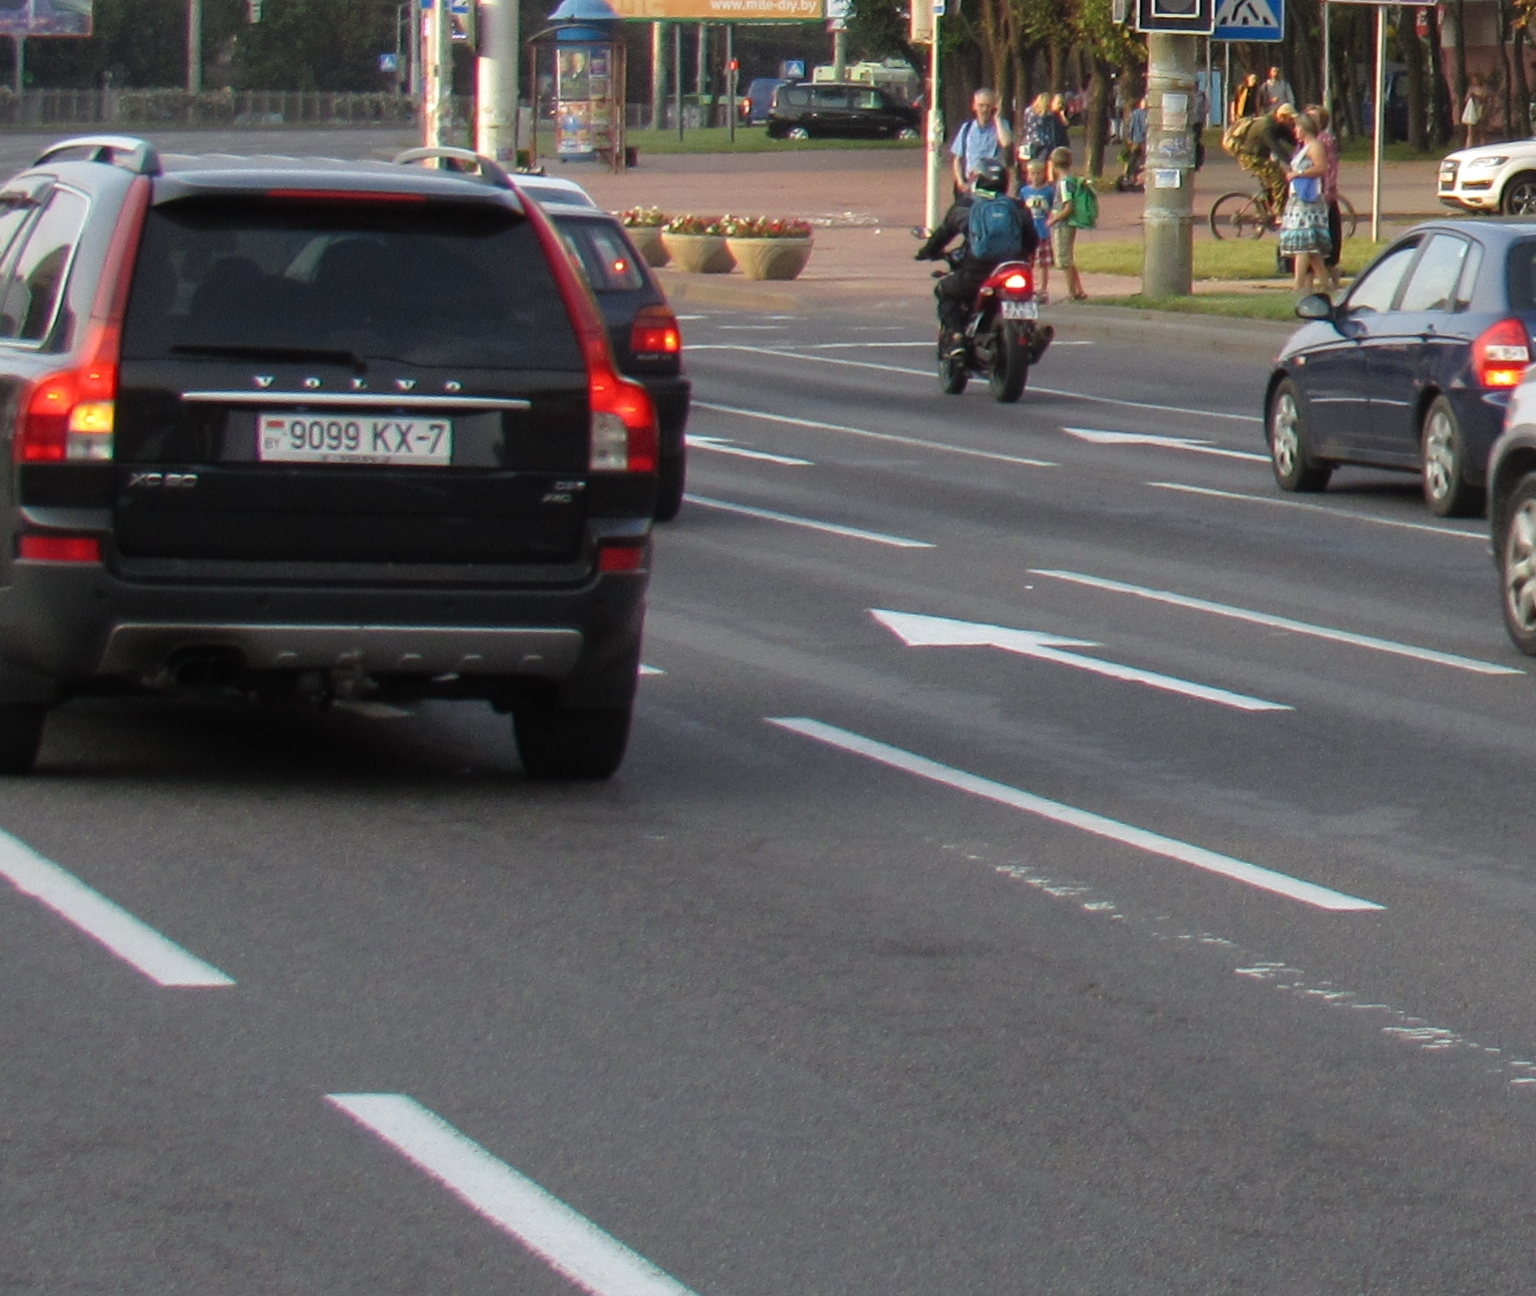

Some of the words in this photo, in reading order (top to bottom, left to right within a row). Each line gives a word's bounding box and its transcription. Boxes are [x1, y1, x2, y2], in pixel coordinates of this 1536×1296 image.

[253, 375, 463, 393] VOLVO
[289, 419, 361, 451] 9099
[371, 421, 448, 455] KX-7
